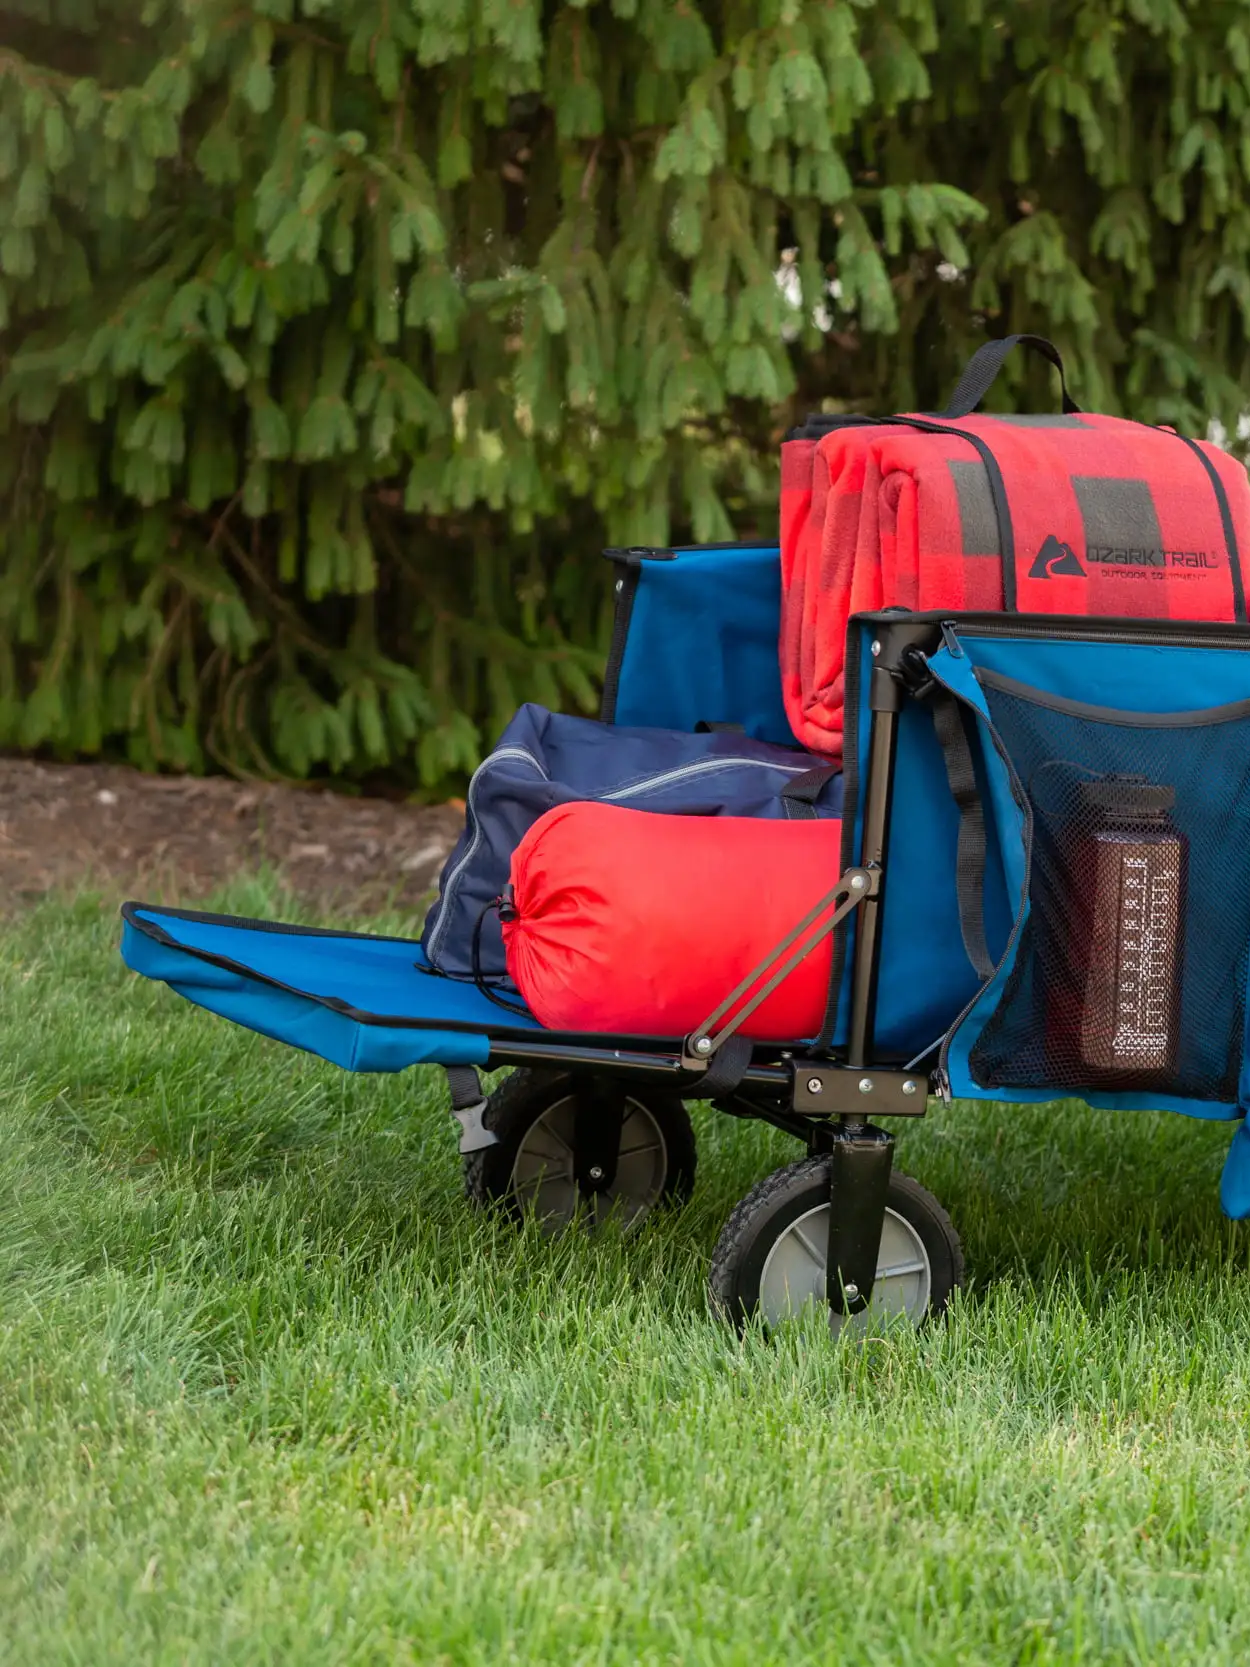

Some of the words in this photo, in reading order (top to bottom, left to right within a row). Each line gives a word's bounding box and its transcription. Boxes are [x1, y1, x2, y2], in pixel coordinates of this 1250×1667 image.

[1086, 547, 1156, 567] OZARK
[1160, 549, 1218, 569] TRAIL
[1101, 569, 1147, 580] OUTDOOR
